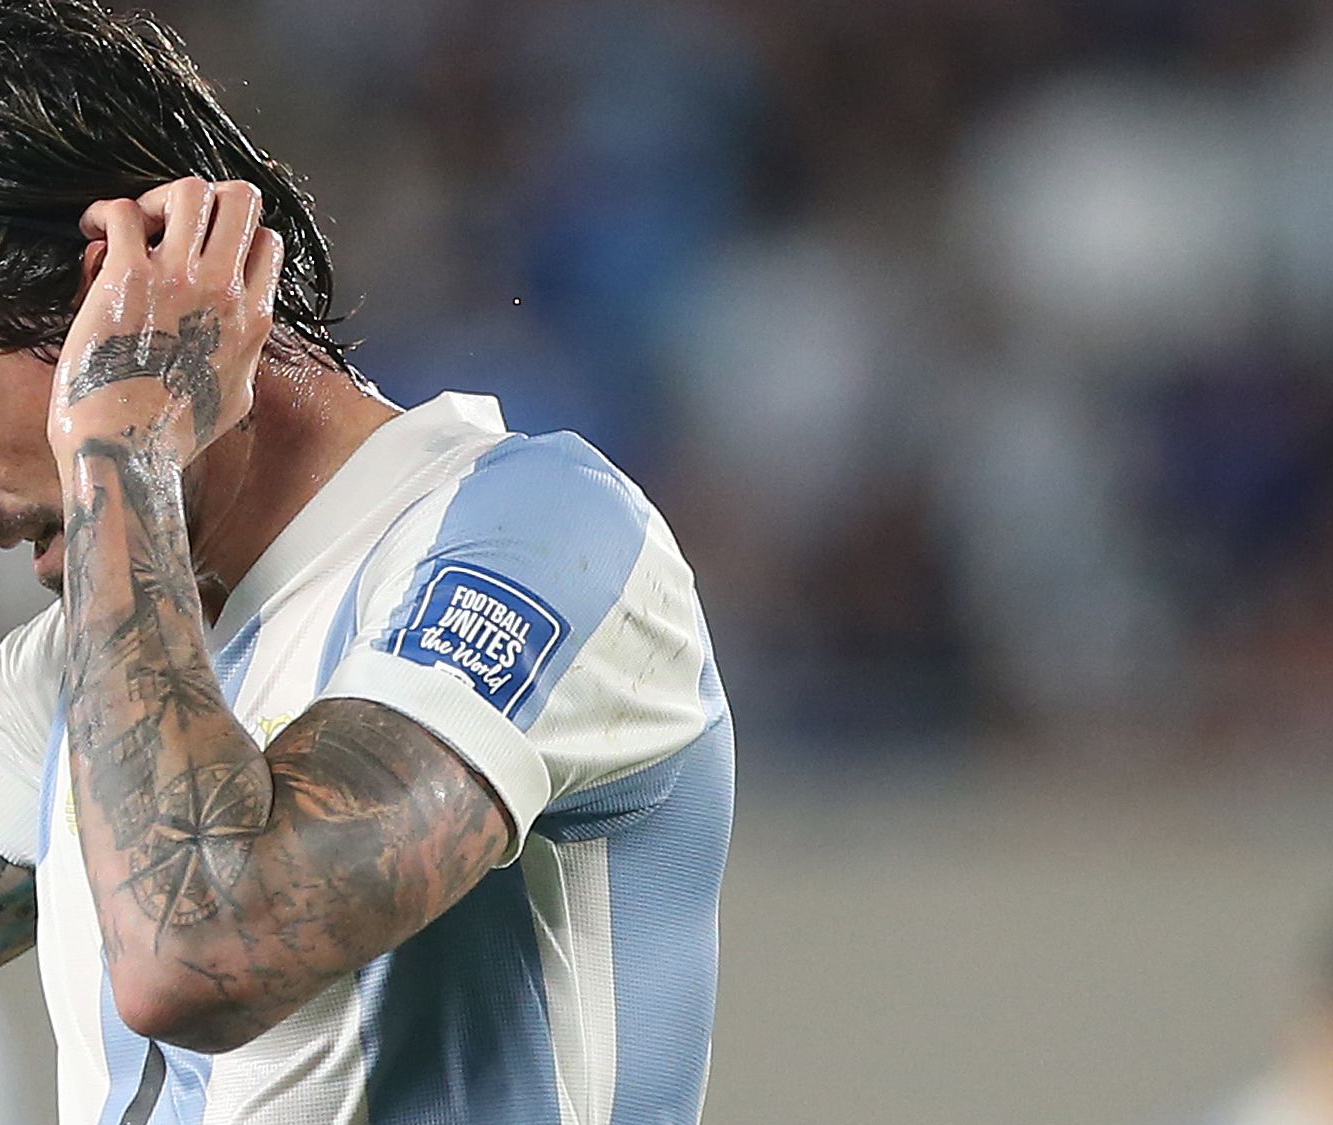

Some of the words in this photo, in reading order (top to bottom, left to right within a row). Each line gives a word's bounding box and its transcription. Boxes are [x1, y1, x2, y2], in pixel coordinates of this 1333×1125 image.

[438, 606, 522, 668] UNITES
[451, 585, 531, 645] FOOTBALL
[420, 626, 454, 654] the
[452, 641, 512, 694] World
